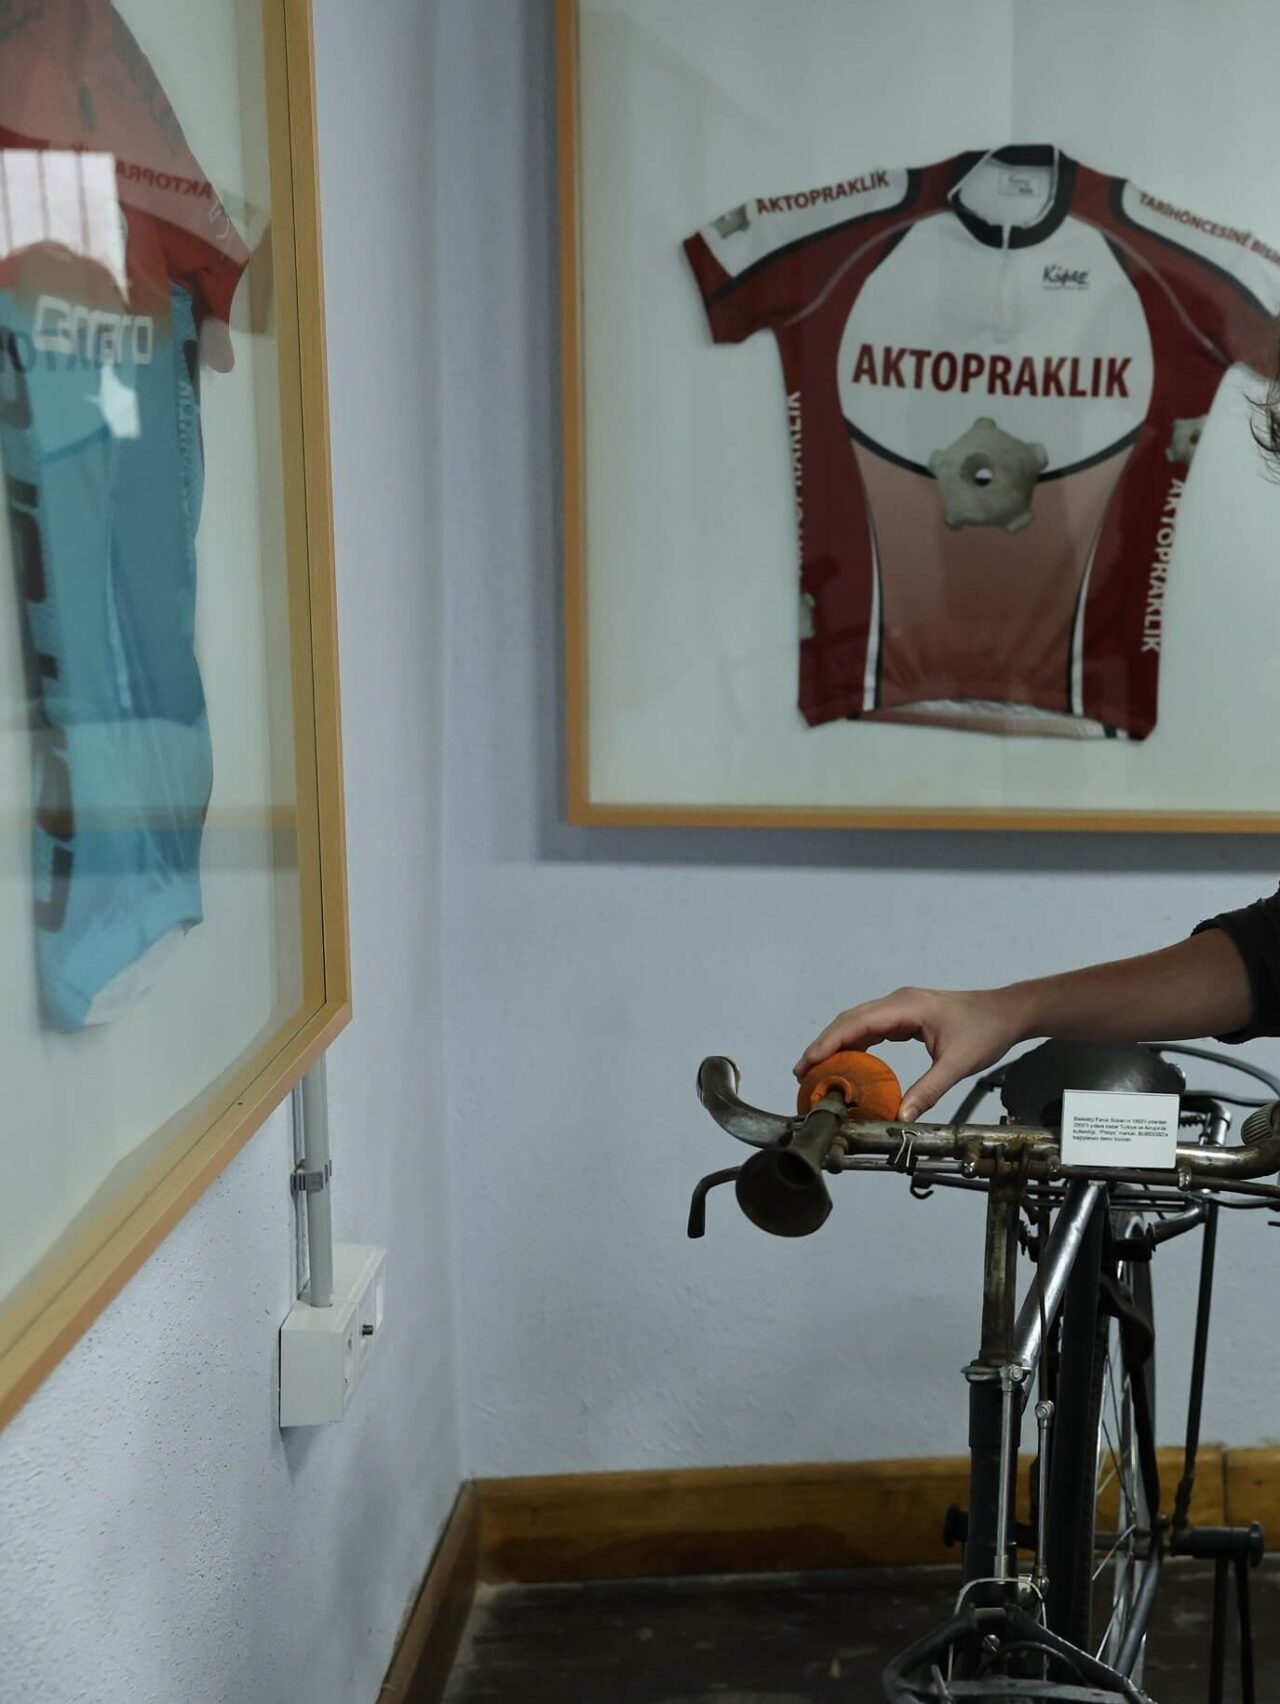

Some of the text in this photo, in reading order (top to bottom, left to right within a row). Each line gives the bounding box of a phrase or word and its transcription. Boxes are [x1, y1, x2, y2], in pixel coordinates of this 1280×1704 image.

[754, 169, 890, 216] AKTOPRAKLIK
[852, 343, 1133, 399] AKTOPRAKLIK
[1140, 476, 1185, 653] AKTOPRAKLIK
